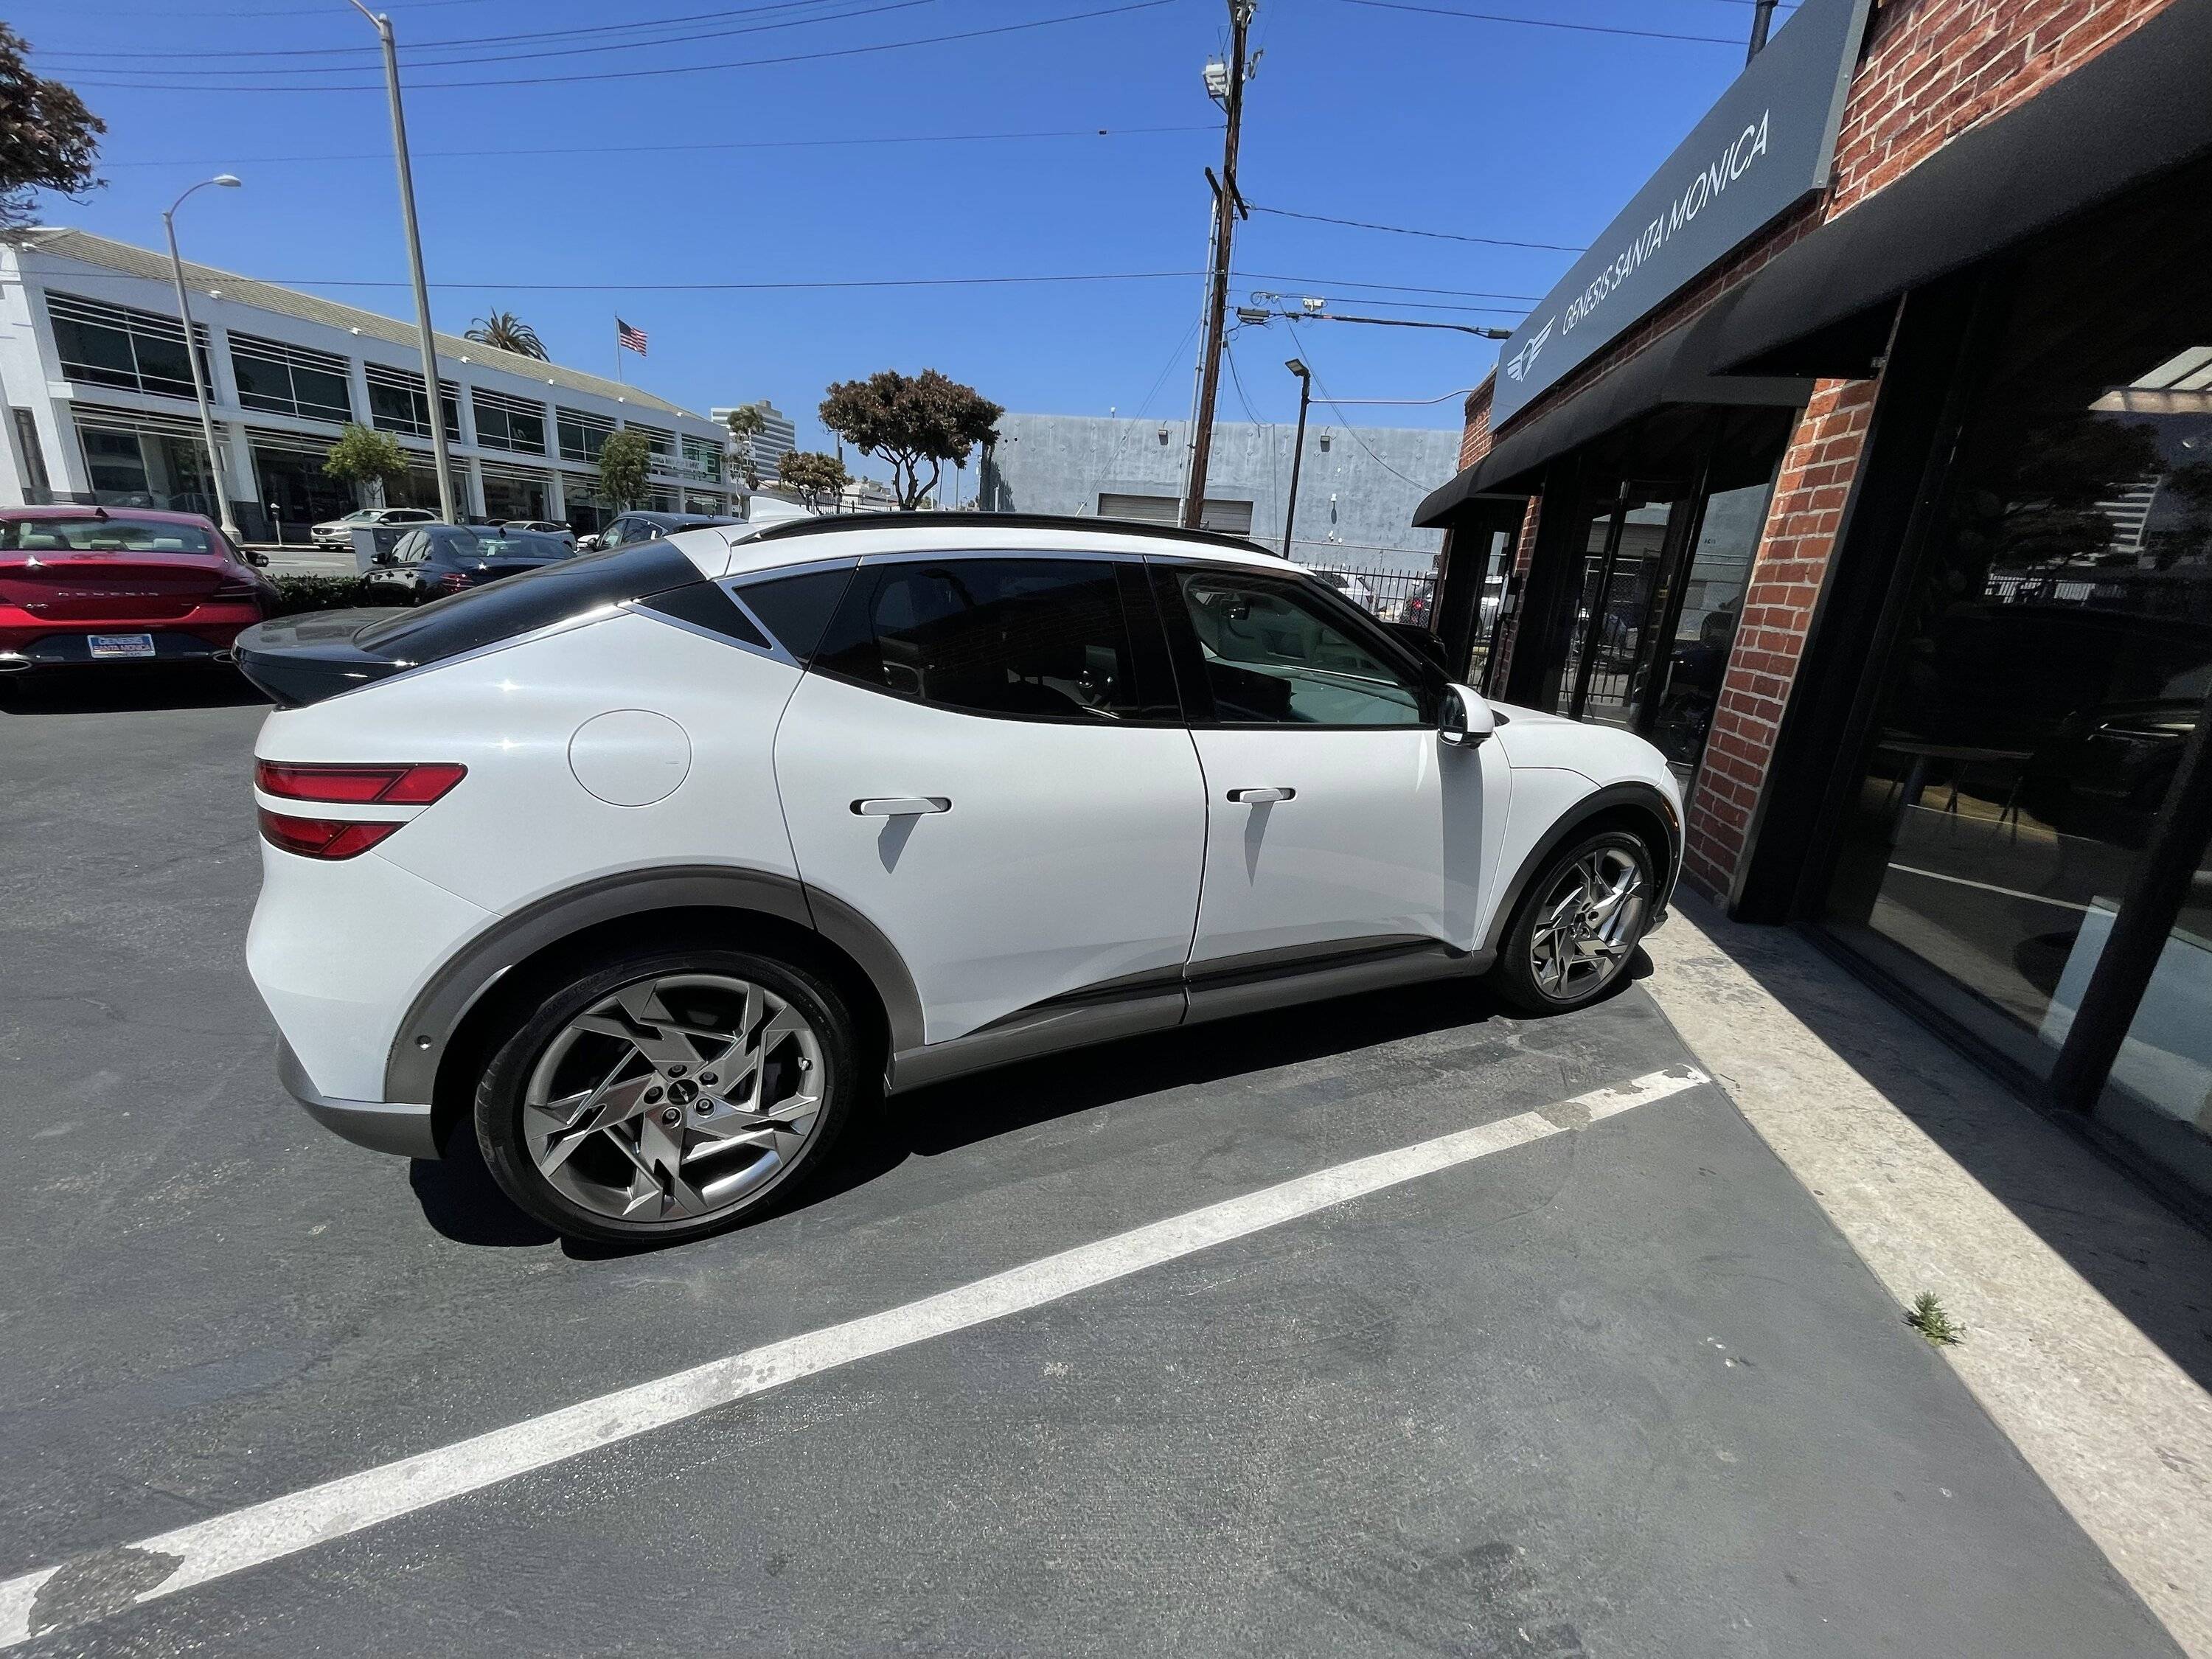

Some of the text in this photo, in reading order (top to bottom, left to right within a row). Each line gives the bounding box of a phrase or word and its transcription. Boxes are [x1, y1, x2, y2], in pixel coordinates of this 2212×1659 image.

[1562, 108, 1770, 336] GENESIS SANTA MONICA
[97, 636, 144, 646] GENESIS
